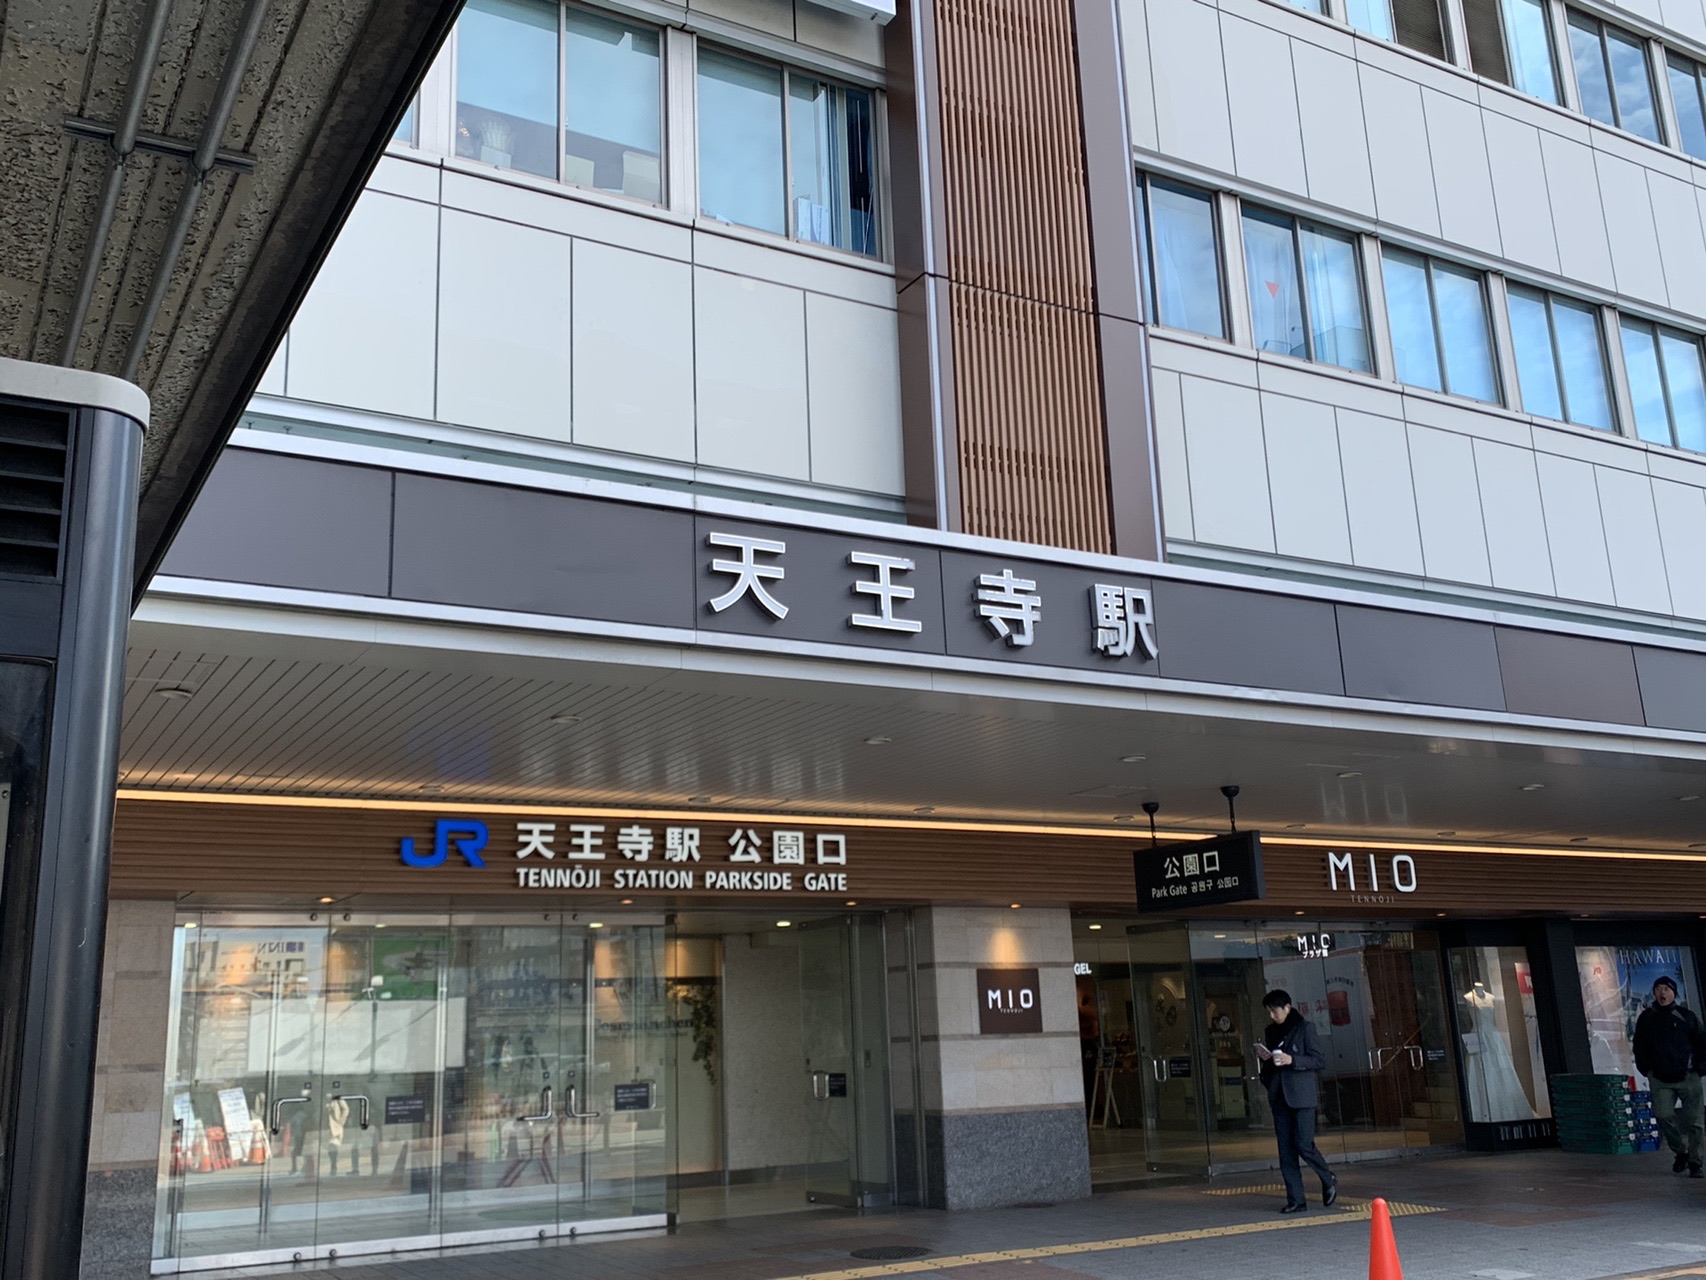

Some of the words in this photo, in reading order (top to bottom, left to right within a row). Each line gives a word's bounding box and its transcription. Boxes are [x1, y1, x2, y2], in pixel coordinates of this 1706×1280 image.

[707, 531, 1159, 660] 天王寺駅
[401, 819, 489, 869] JR
[516, 822, 701, 862] 天王寺駅
[728, 828, 847, 865] 公園口
[516, 864, 601, 889] TENNŌJI
[614, 869, 693, 890] STATION
[705, 870, 792, 891] PARKSIDE
[804, 872, 847, 891] GATE
[1163, 851, 1220, 879] 公園口
[1328, 852, 1417, 892] MIO
[1151, 885, 1168, 899] Park
[1169, 884, 1188, 896] Gate
[1350, 894, 1395, 904] TENNOJI
[1619, 948, 1678, 965] HAWAII
[987, 988, 1034, 1010] MIO
